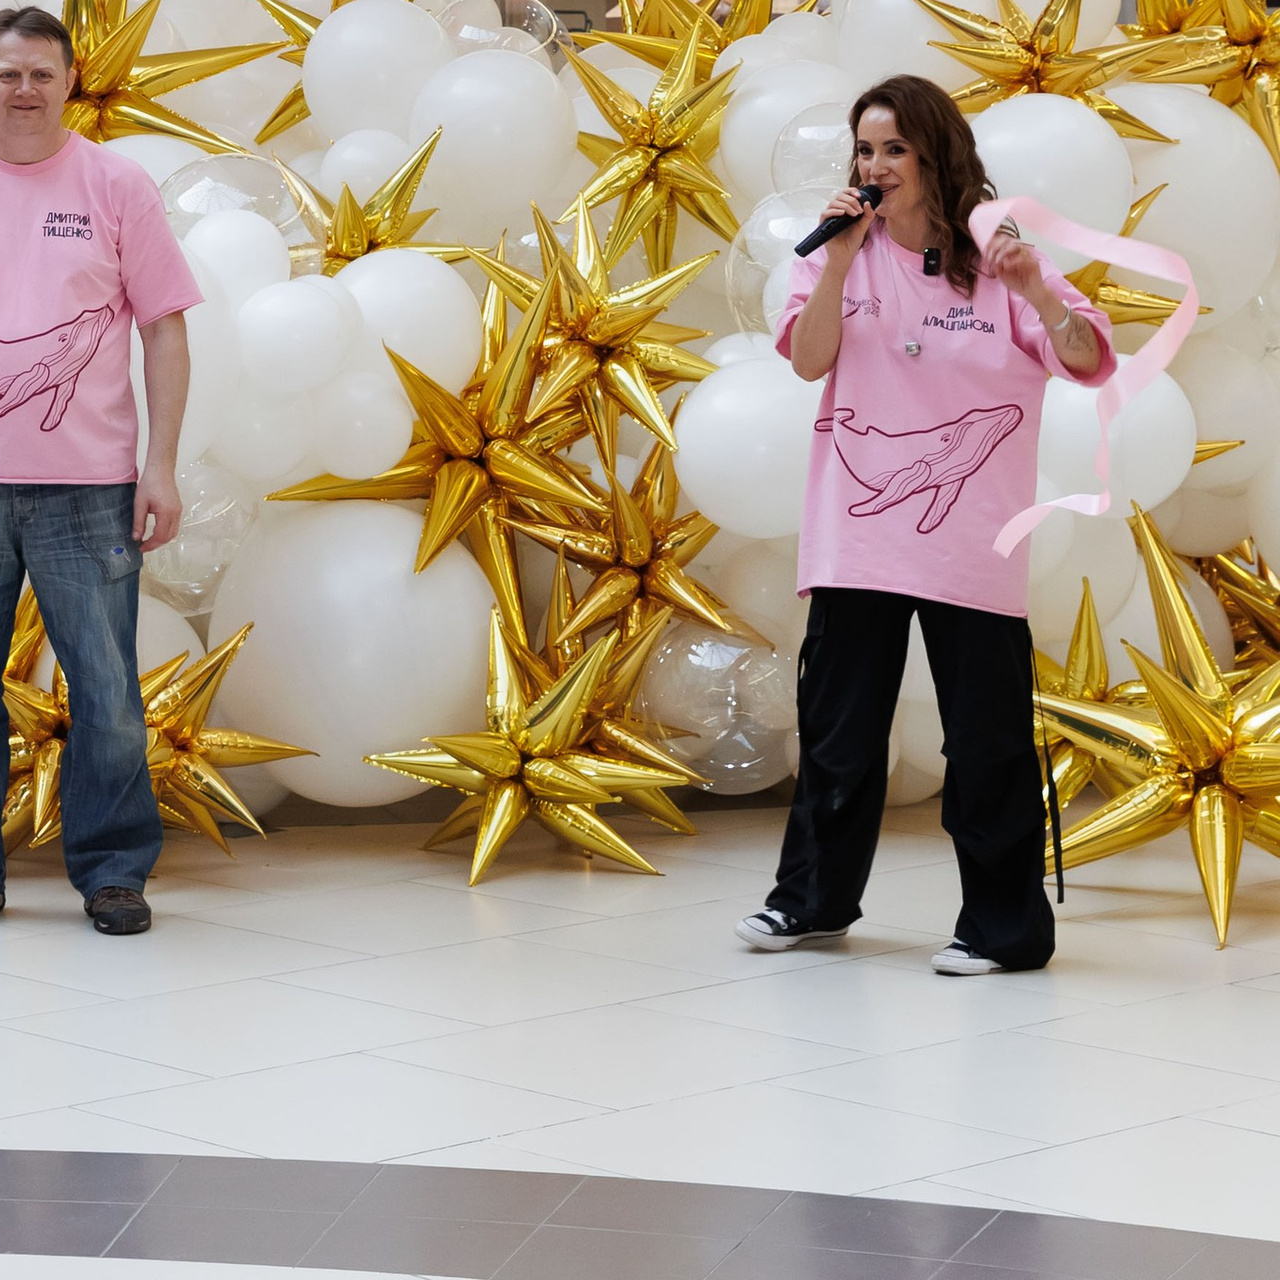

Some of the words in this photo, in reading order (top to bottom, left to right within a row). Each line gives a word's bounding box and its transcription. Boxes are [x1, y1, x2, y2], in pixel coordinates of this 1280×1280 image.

[45, 212, 91, 226] ДМИТРИЙ
[42, 226, 93, 241] ТИЩЕНКО
[946, 305, 974, 319] ДИНА
